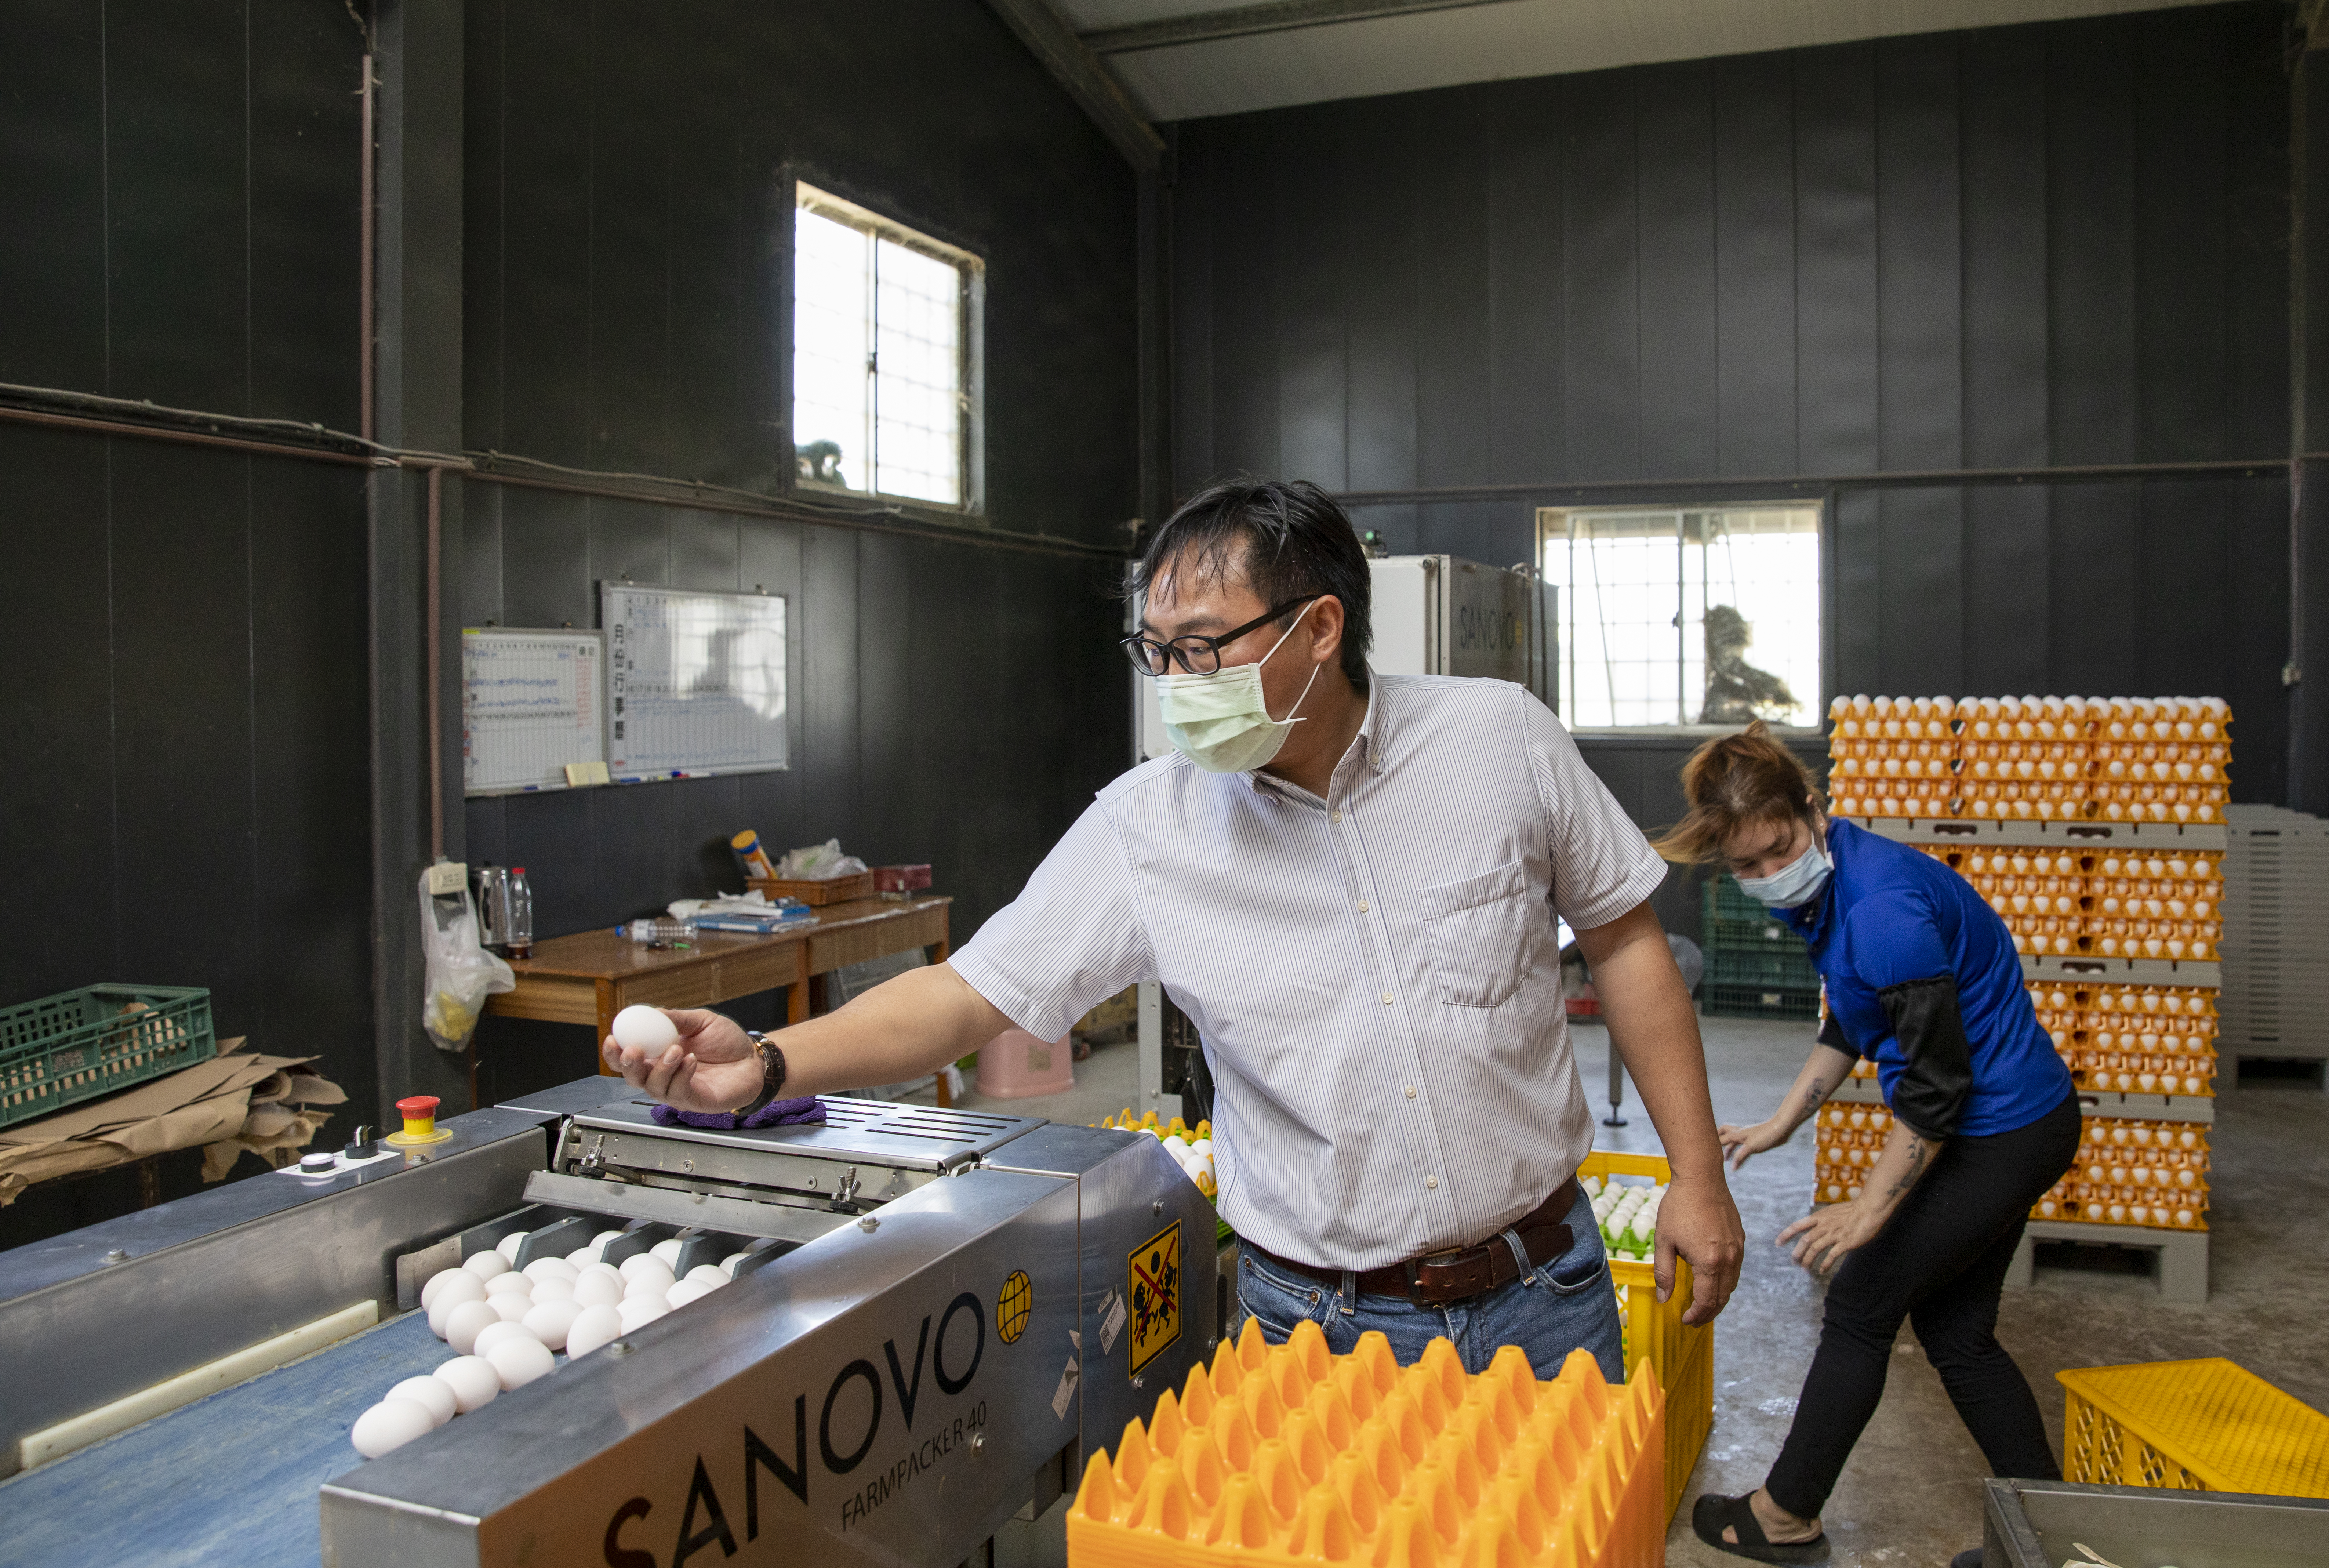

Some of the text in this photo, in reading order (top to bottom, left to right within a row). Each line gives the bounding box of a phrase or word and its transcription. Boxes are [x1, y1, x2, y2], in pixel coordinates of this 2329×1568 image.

[1460, 606, 1515, 651] SANOVO
[604, 1292, 985, 1568] SANOVO
[842, 1400, 986, 1532] FARMPACKER 40
